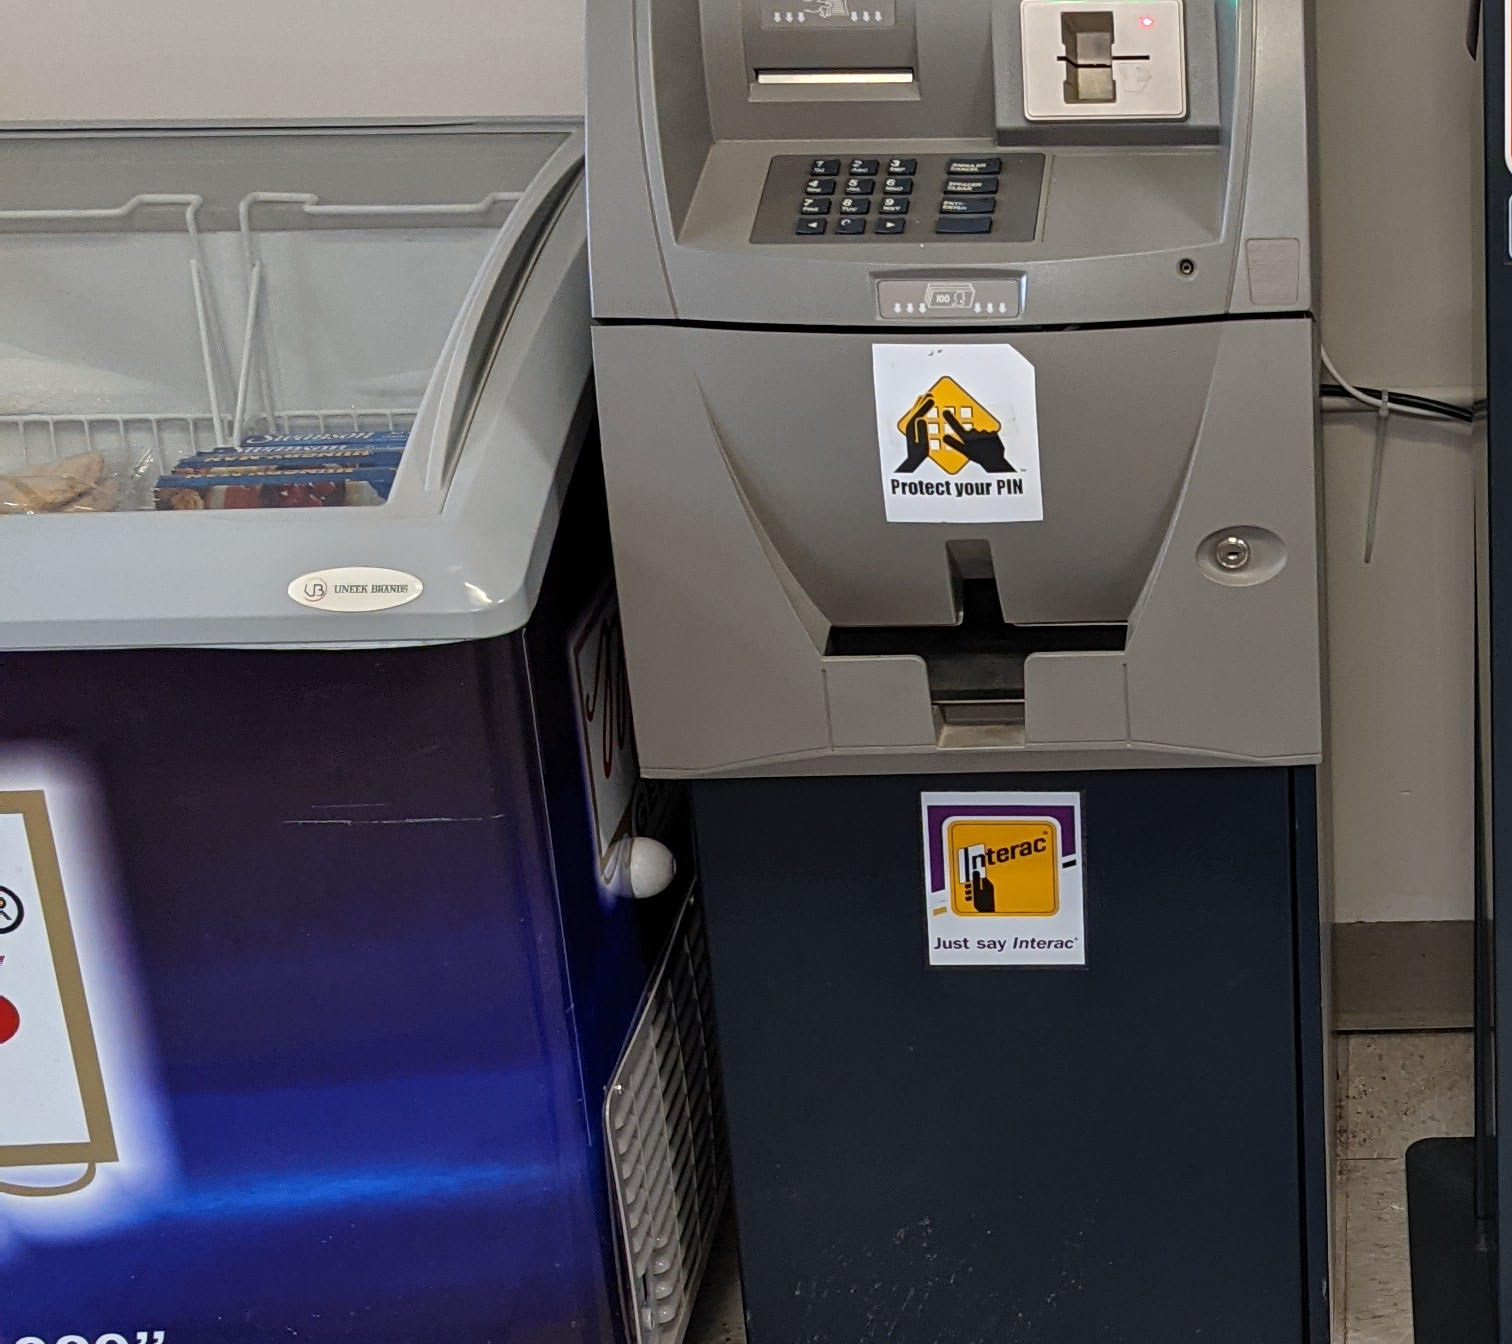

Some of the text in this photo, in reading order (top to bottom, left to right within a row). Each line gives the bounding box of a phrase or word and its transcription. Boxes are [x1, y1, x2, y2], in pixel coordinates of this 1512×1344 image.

[935, 293, 951, 304] 100
[891, 478, 1024, 497] Protect your PIN
[371, 584, 408, 593] BRANDS
[964, 837, 1047, 882] Interac
[934, 937, 1074, 952] Just say Interac
